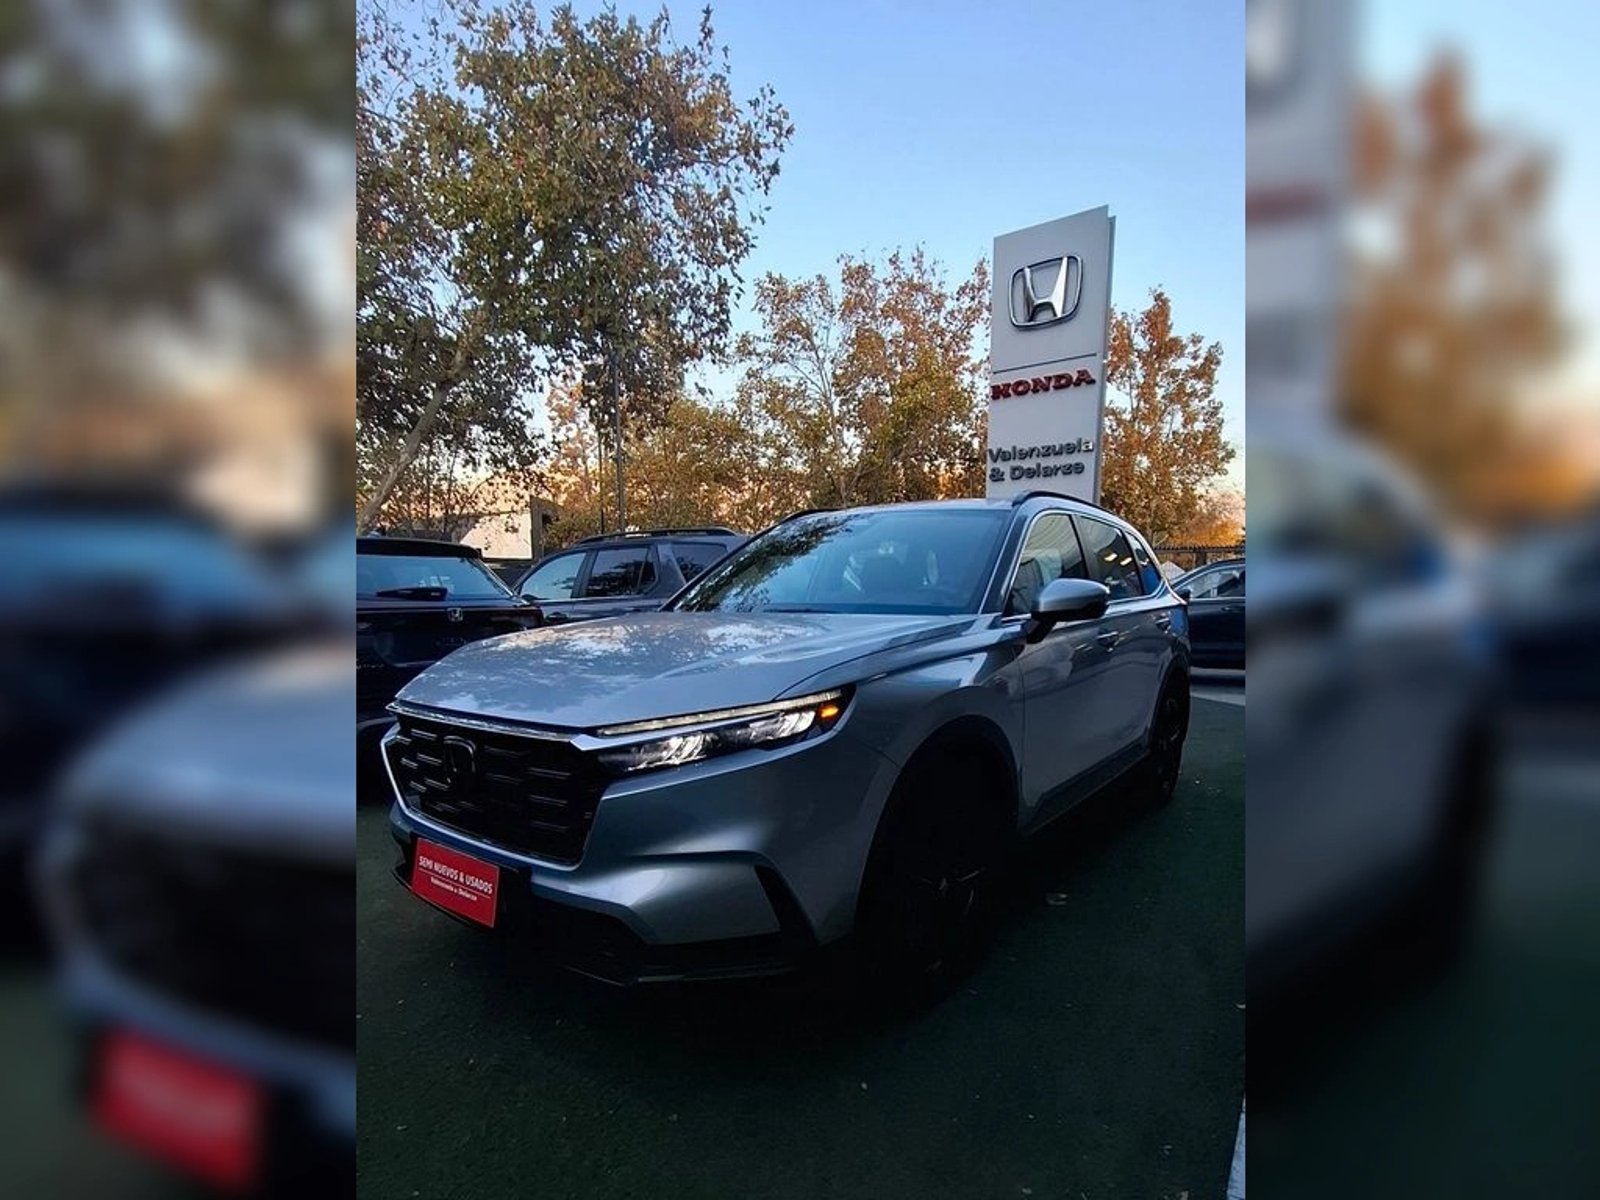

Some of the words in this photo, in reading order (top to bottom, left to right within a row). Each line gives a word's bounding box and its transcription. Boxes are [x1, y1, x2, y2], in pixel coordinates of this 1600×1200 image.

[991, 369, 1096, 400] HONDA
[988, 438, 1095, 463] Valenzuela
[989, 467, 1005, 482] &
[1009, 462, 1085, 480] Delarze
[465, 875, 492, 894] USADOS
